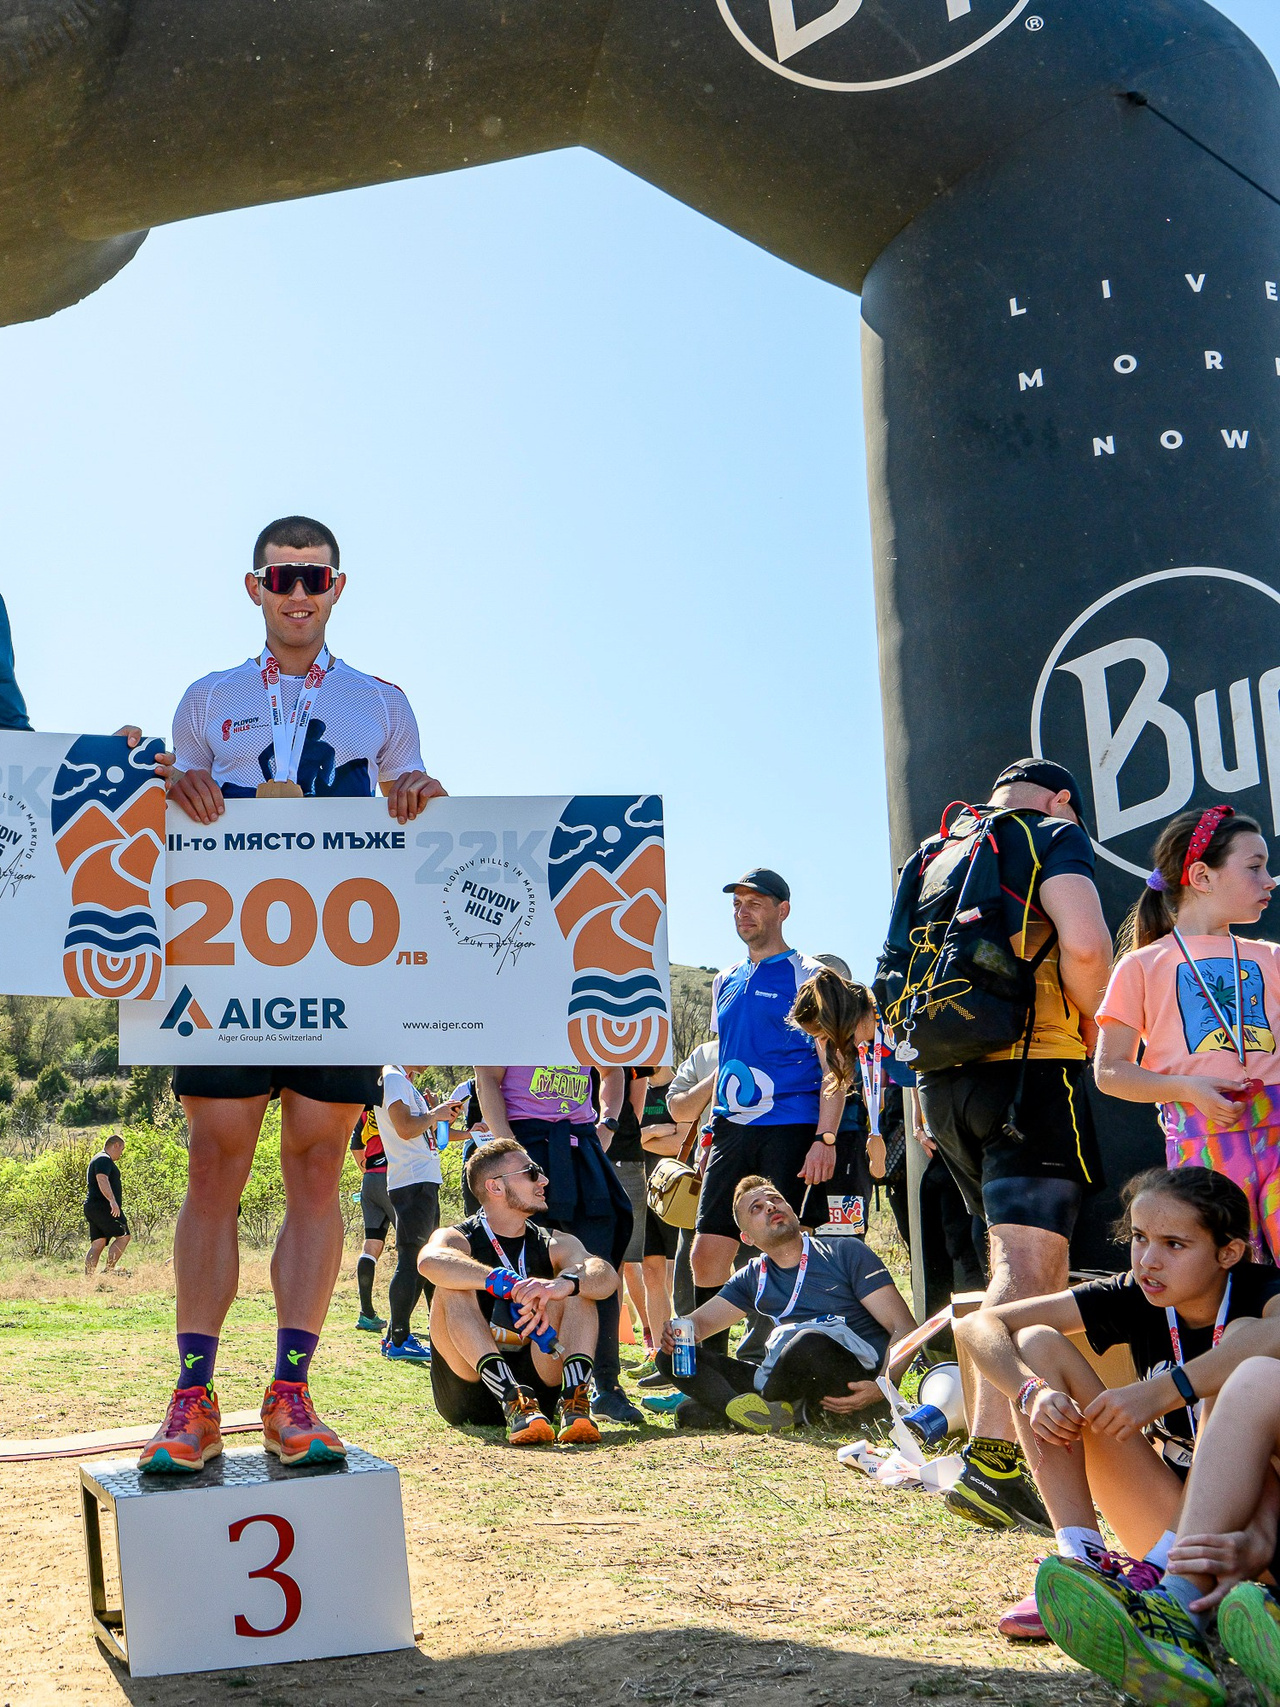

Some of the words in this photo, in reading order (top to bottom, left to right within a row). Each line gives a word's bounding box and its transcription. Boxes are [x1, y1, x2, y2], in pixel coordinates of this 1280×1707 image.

[1092, 428, 1250, 457] NOW
[16, 800, 26, 811] IN
[26, 813, 38, 860] MARKOVO
[224, 832, 316, 850] МЯСТО
[322, 831, 406, 850] МЪЖЕ
[443, 860, 475, 893] PLOVDIV
[480, 856, 510, 868] HILLS
[512, 866, 522, 877] IN
[522, 879, 536, 927] MARKOVO
[461, 880, 520, 914] PLOVDIV
[165, 877, 400, 967] 200
[443, 909, 461, 936] TRAIL
[464, 900, 504, 926] HILLS
[218, 996, 349, 1030] AIGER
[402, 1020, 484, 1032] www.aiger.com
[218, 1034, 239, 1044] Aiger
[240, 1034, 264, 1044] Group
[265, 1034, 278, 1042] AG
[278, 1034, 322, 1042] Switzerland
[970, 1476, 998, 1497] SCARPA
[228, 1514, 302, 1638] 3
